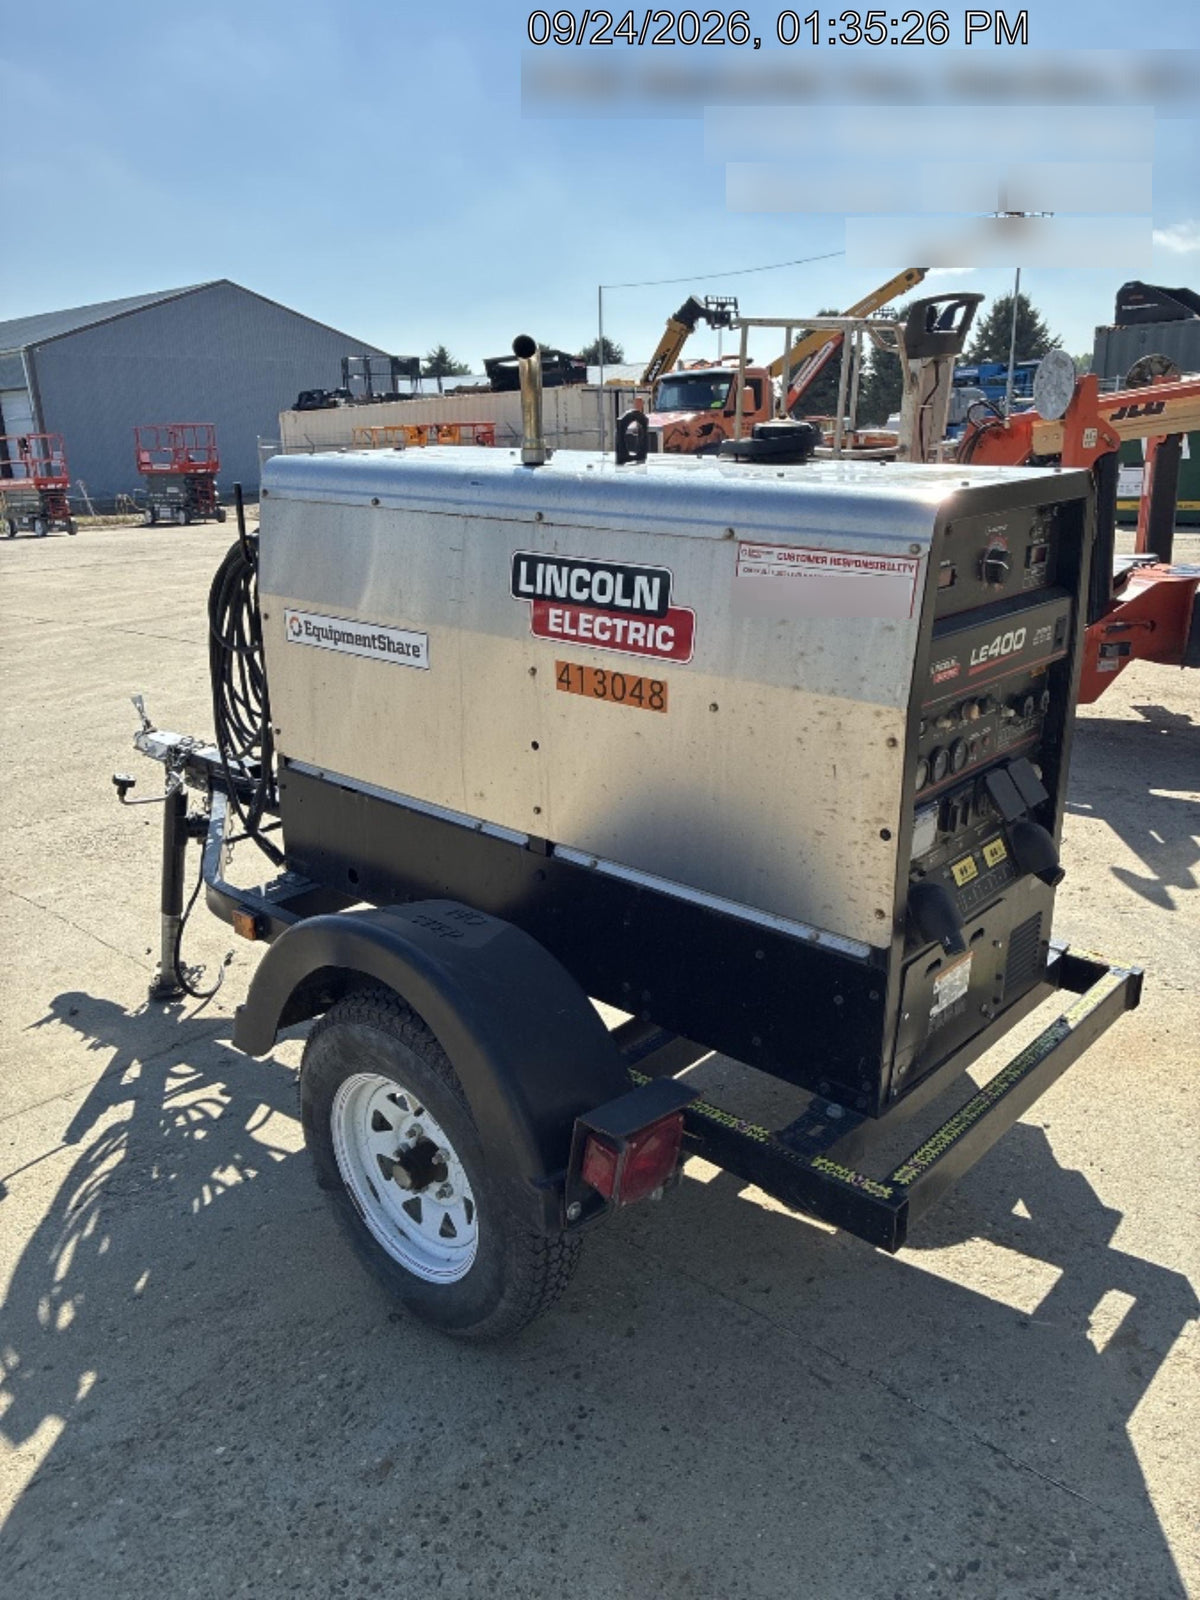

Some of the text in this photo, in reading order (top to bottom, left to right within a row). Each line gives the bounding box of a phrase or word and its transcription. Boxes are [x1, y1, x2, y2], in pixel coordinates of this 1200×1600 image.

[518, 560, 661, 612] LINCOLN
[303, 620, 421, 659] EquipmentShare
[548, 607, 675, 652] ELECTRIC
[970, 626, 1026, 666] LE400
[557, 663, 665, 711] 413048
